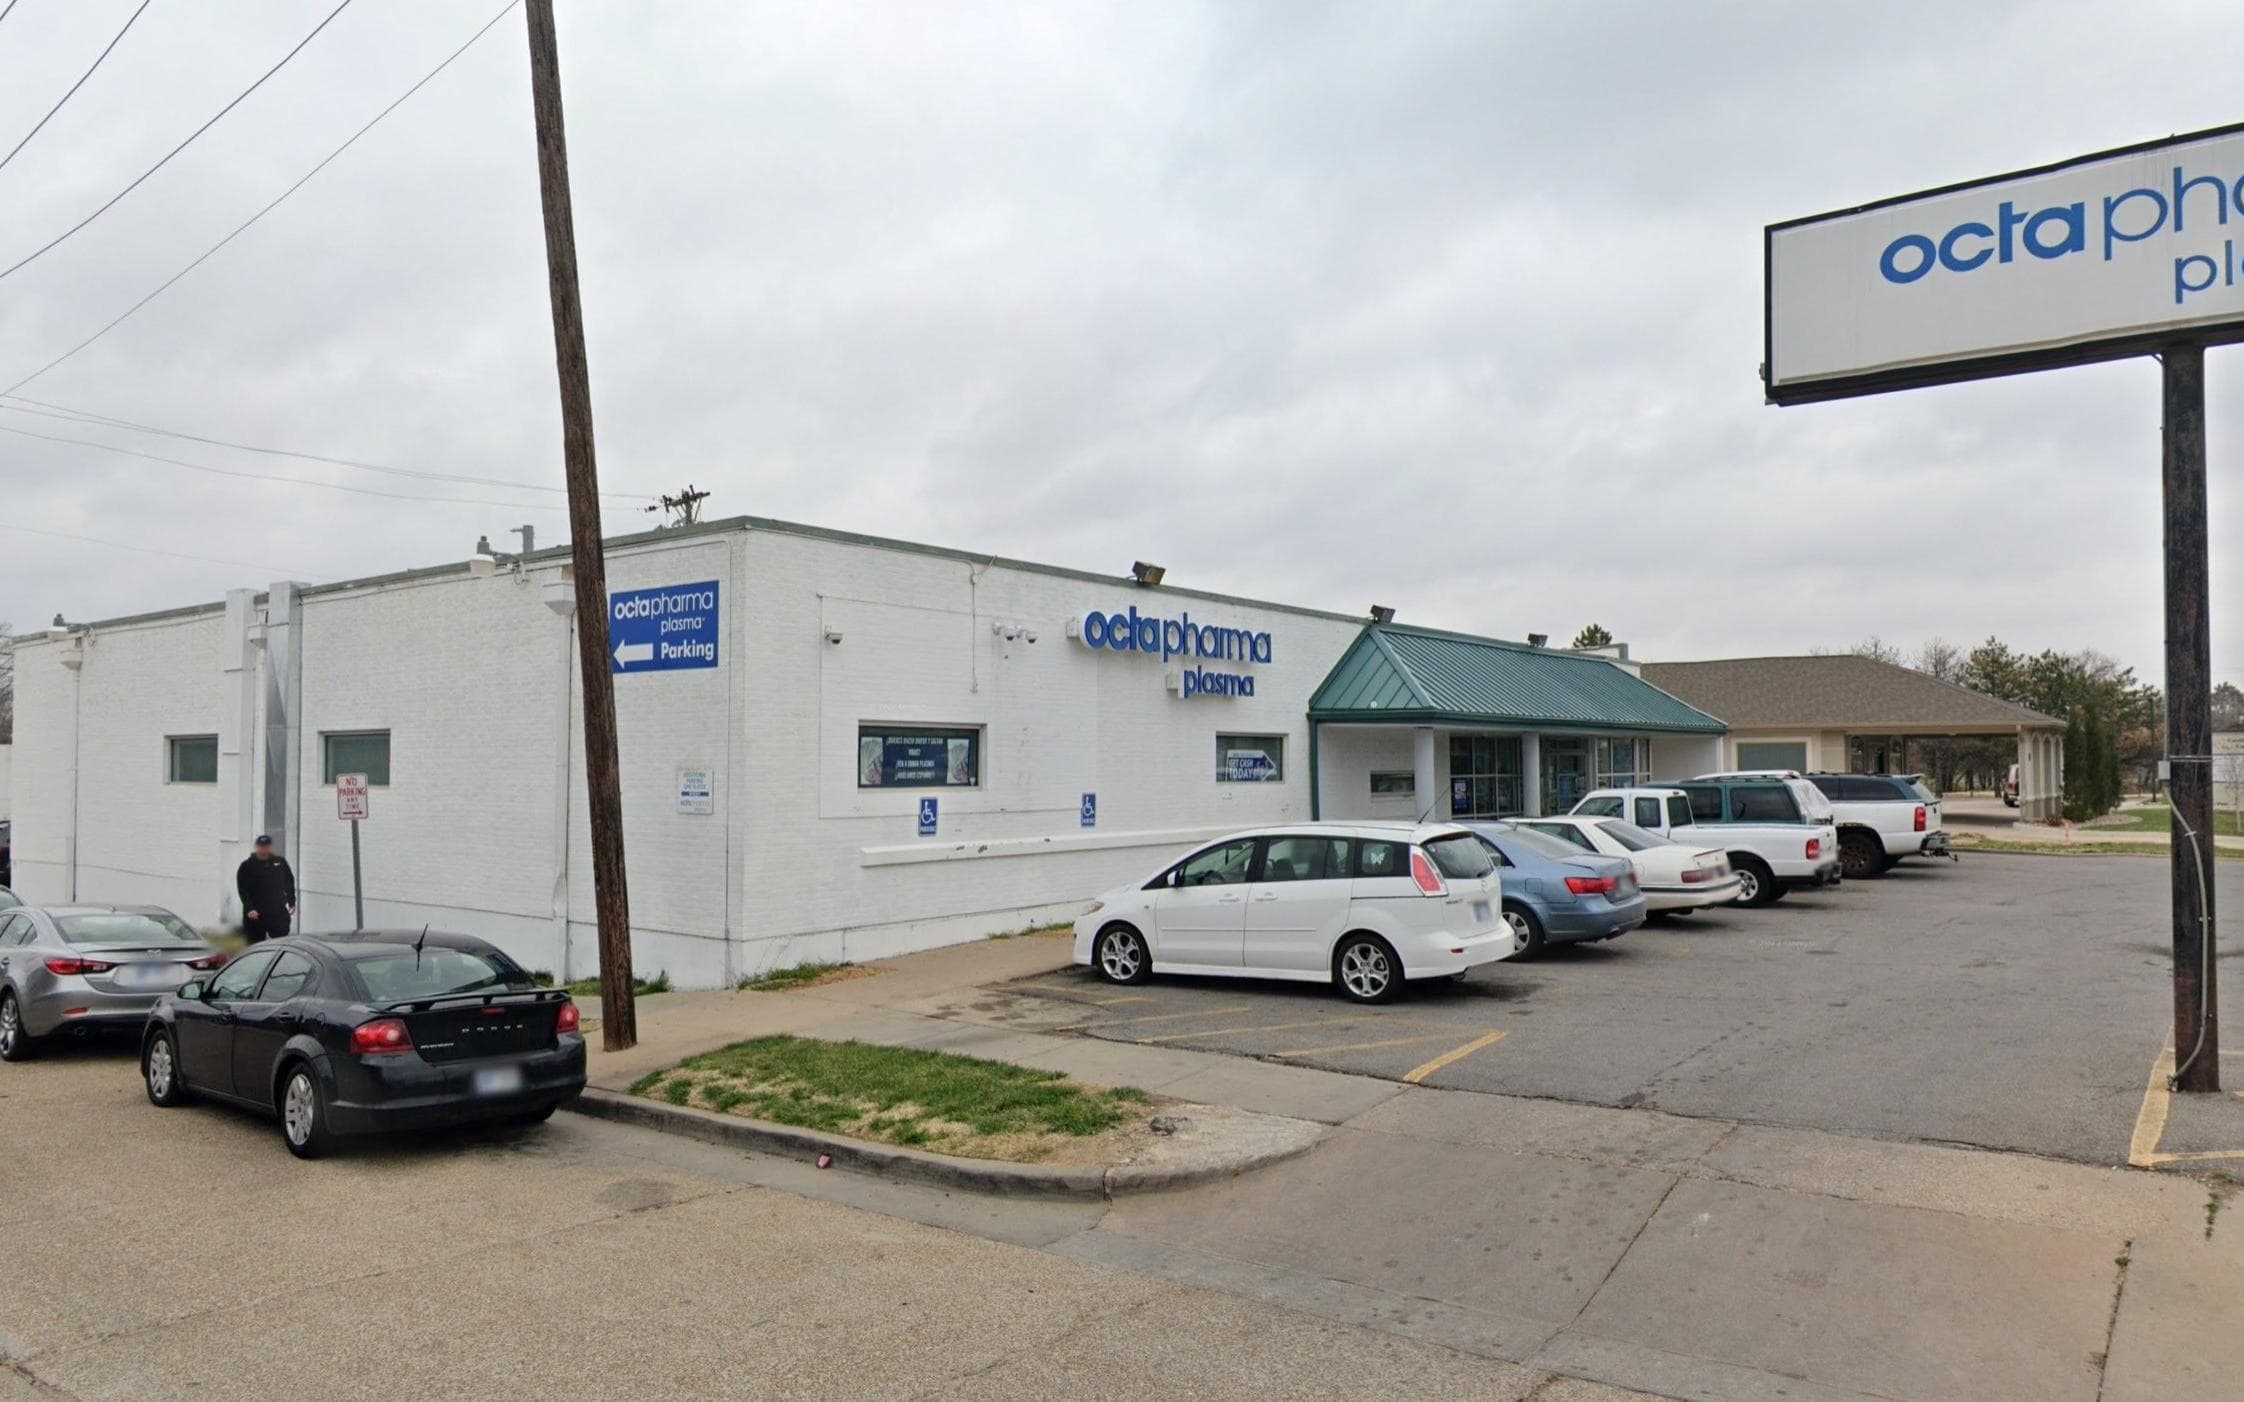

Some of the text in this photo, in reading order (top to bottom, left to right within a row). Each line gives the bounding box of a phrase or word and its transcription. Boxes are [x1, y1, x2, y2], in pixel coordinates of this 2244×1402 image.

[1880, 167, 2244, 284] octaph
[2175, 239, 2244, 304] pl
[614, 591, 713, 620] octapharma
[660, 616, 702, 636] plasma
[1085, 606, 1271, 663] octapharma
[661, 639, 714, 660] Parking
[1184, 665, 1254, 698] plasma
[338, 787, 366, 796] PARKING
[346, 777, 357, 786] NO
